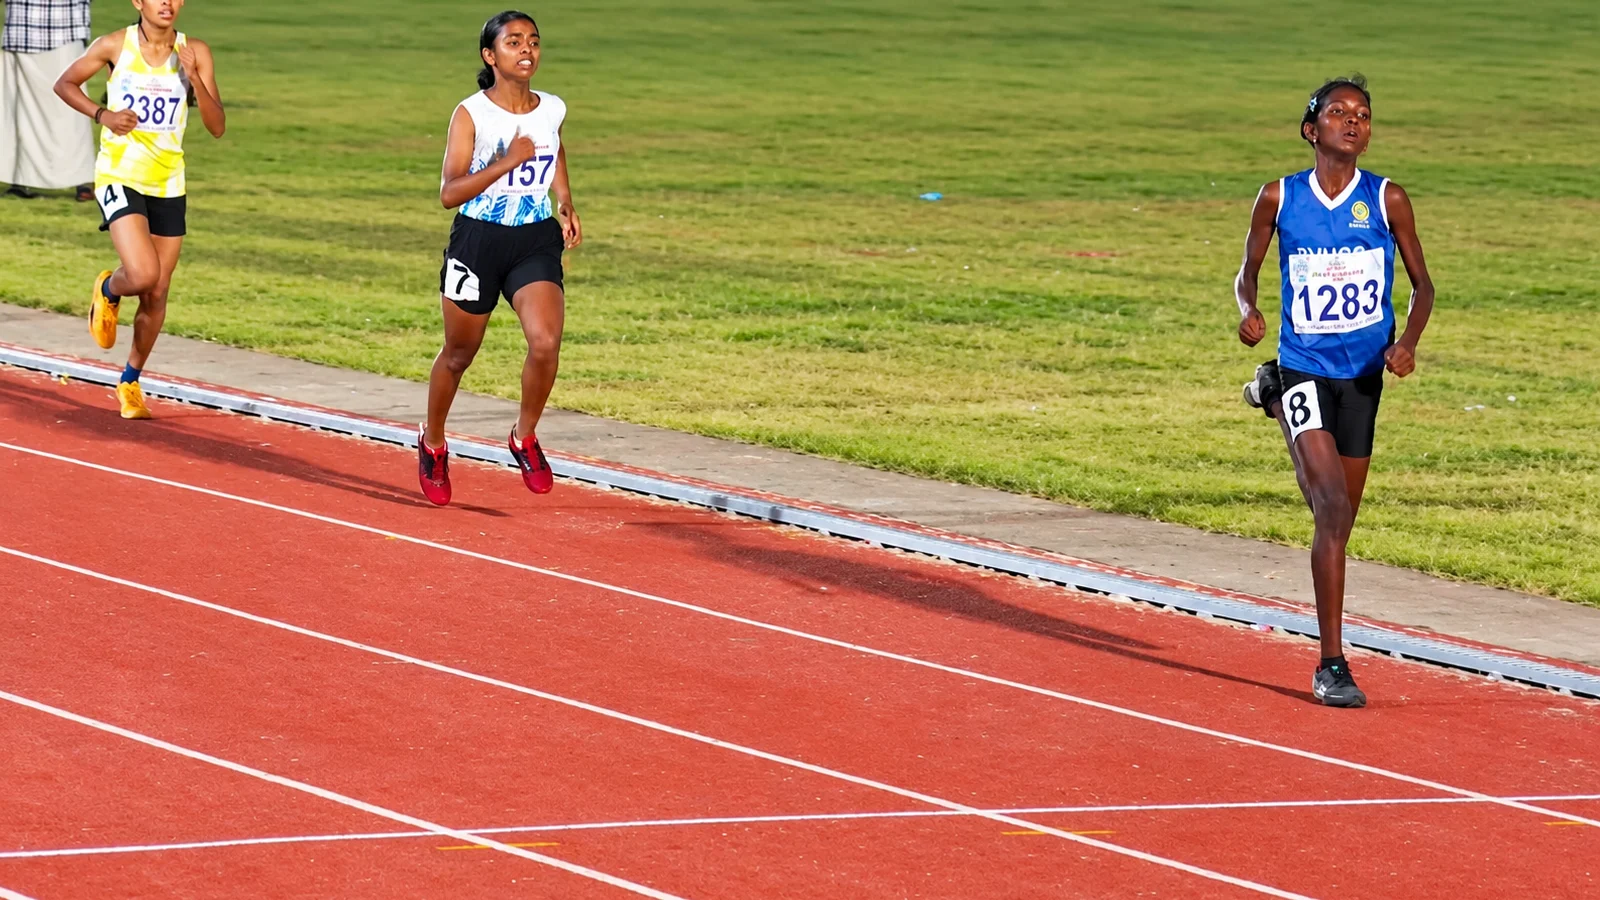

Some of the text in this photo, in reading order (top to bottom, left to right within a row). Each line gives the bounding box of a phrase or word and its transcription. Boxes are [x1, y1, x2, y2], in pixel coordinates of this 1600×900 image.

[123, 94, 181, 125] 2387
[103, 184, 118, 206] 4
[453, 264, 470, 295] 7
[1298, 279, 1379, 322] 1283
[1289, 391, 1311, 428] 8
